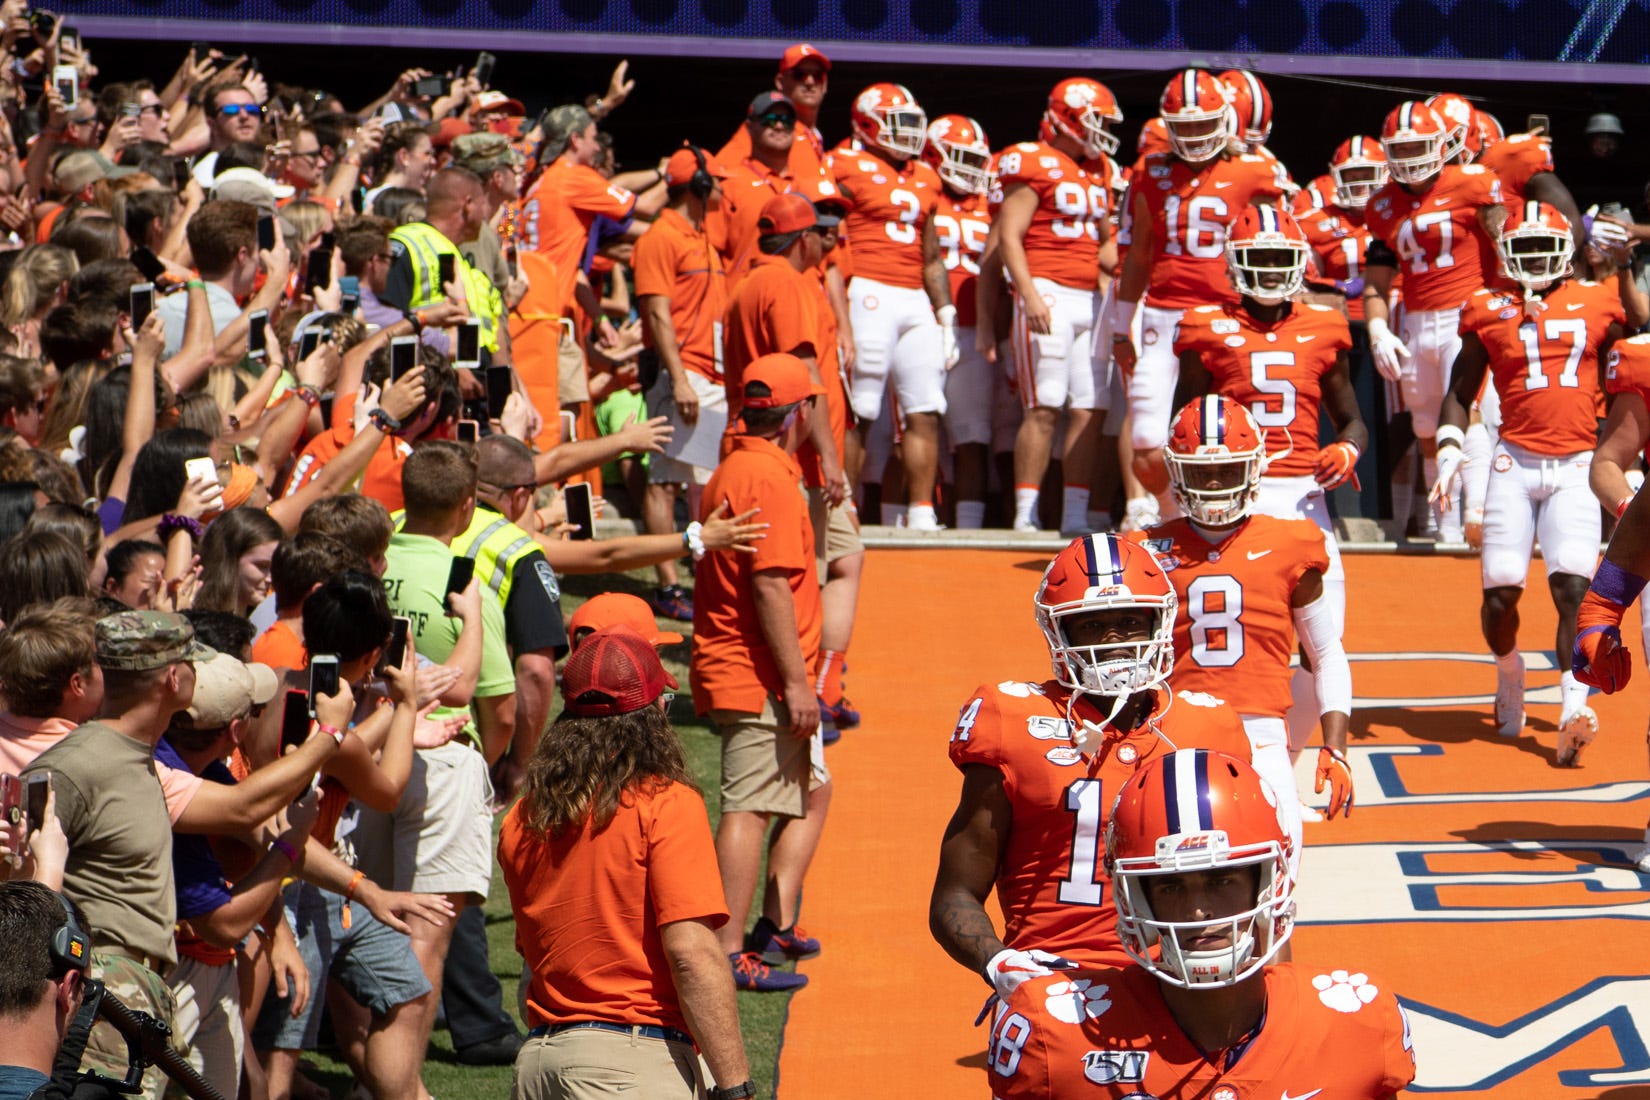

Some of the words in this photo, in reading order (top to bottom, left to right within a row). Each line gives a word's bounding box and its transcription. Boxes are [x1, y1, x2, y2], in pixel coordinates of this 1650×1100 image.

[886, 189, 921, 244] 3
[934, 215, 989, 275] 35
[1165, 195, 1228, 258] 16
[1396, 210, 1455, 274] 47
[1518, 318, 1587, 391] 17
[1250, 351, 1296, 427] 5
[1187, 574, 1244, 667] 8
[1177, 835, 1209, 850] ACC
[1192, 966, 1209, 975] ALL
[1210, 966, 1220, 974] IN
[1083, 1051, 1149, 1083] 150
